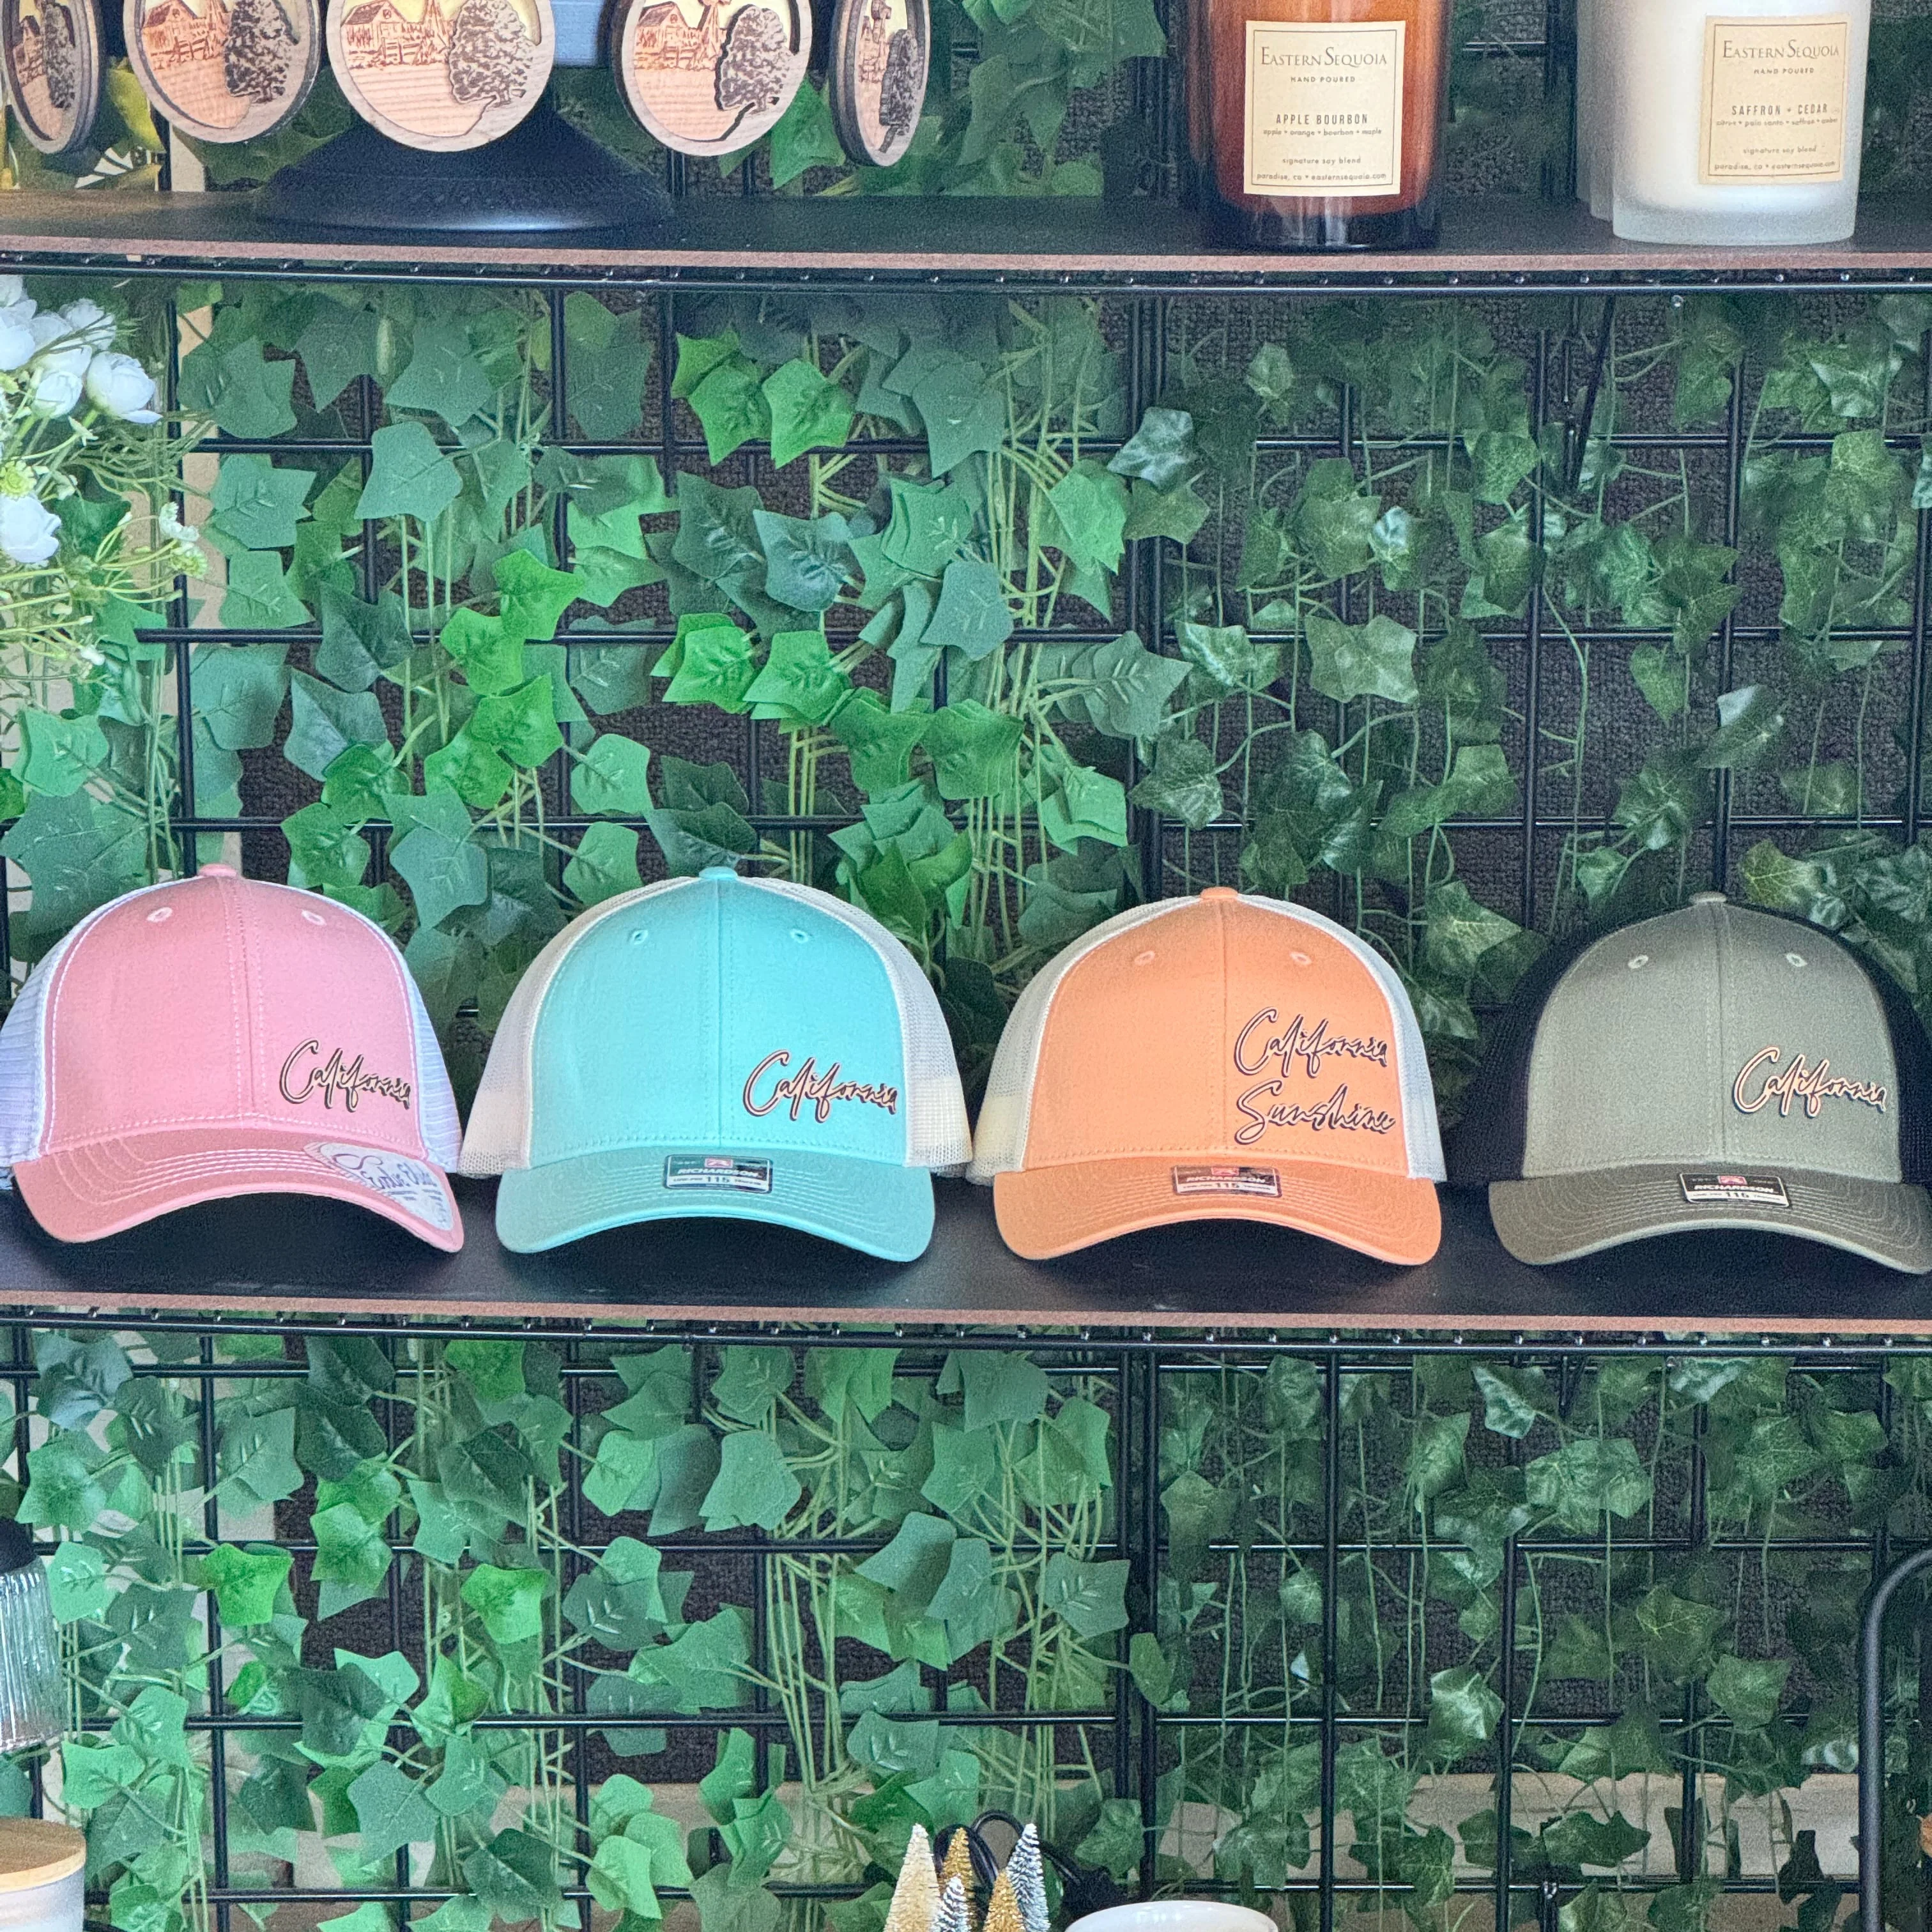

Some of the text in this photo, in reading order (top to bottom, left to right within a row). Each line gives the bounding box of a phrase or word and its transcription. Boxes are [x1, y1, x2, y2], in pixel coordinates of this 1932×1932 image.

[1261, 47, 1387, 68] EASTERN SEQUOIA
[1723, 40, 1839, 59] EASTERN SEQUOIA
[1276, 114, 1368, 125] APPLE BOURBON
[1731, 103, 1828, 116] SAFFRON CEDAR
[1263, 128, 1282, 137] apple
[1234, 1006, 1388, 1078] California
[279, 1038, 411, 1112] California
[1732, 1045, 1887, 1119] California
[742, 1049, 898, 1123] California
[1234, 1078, 1396, 1146] Sunshine
[677, 1168, 759, 1177] RICHARDSON
[1694, 1184, 1774, 1193] RICHARDSON
